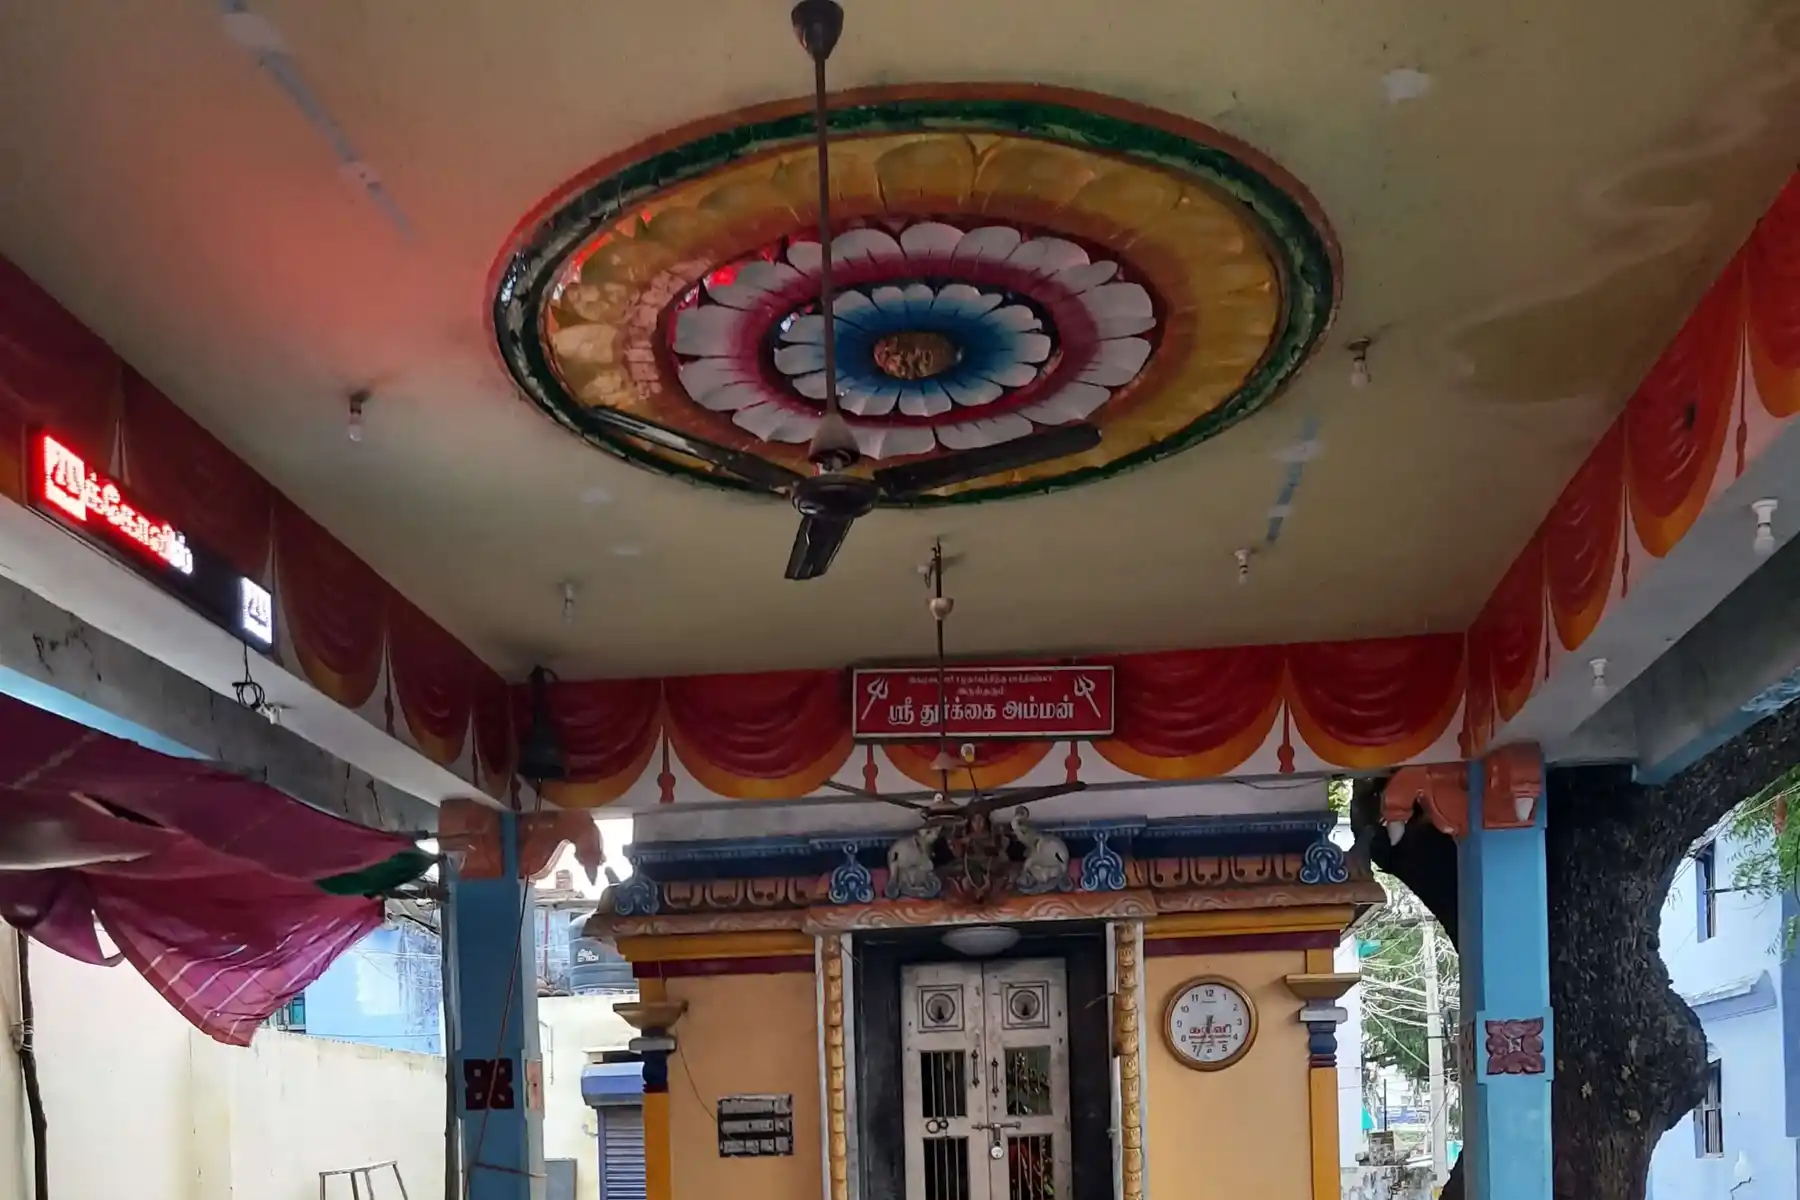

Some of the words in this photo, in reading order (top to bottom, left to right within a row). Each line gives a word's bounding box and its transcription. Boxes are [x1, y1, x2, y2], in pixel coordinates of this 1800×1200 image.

[888, 696, 915, 725] ஸ்ரீ
[920, 695, 997, 726] துர்க்கை
[1002, 694, 1075, 720] அம்மன்
[1205, 989, 1214, 997] 12
[1191, 994, 1199, 1002] 11
[1181, 1005, 1189, 1013] 10
[1176, 1020, 1182, 1028] 9
[1237, 1018, 1242, 1026] 3
[1192, 1045, 1197, 1053] 7
[1222, 1044, 1227, 1052] 5
